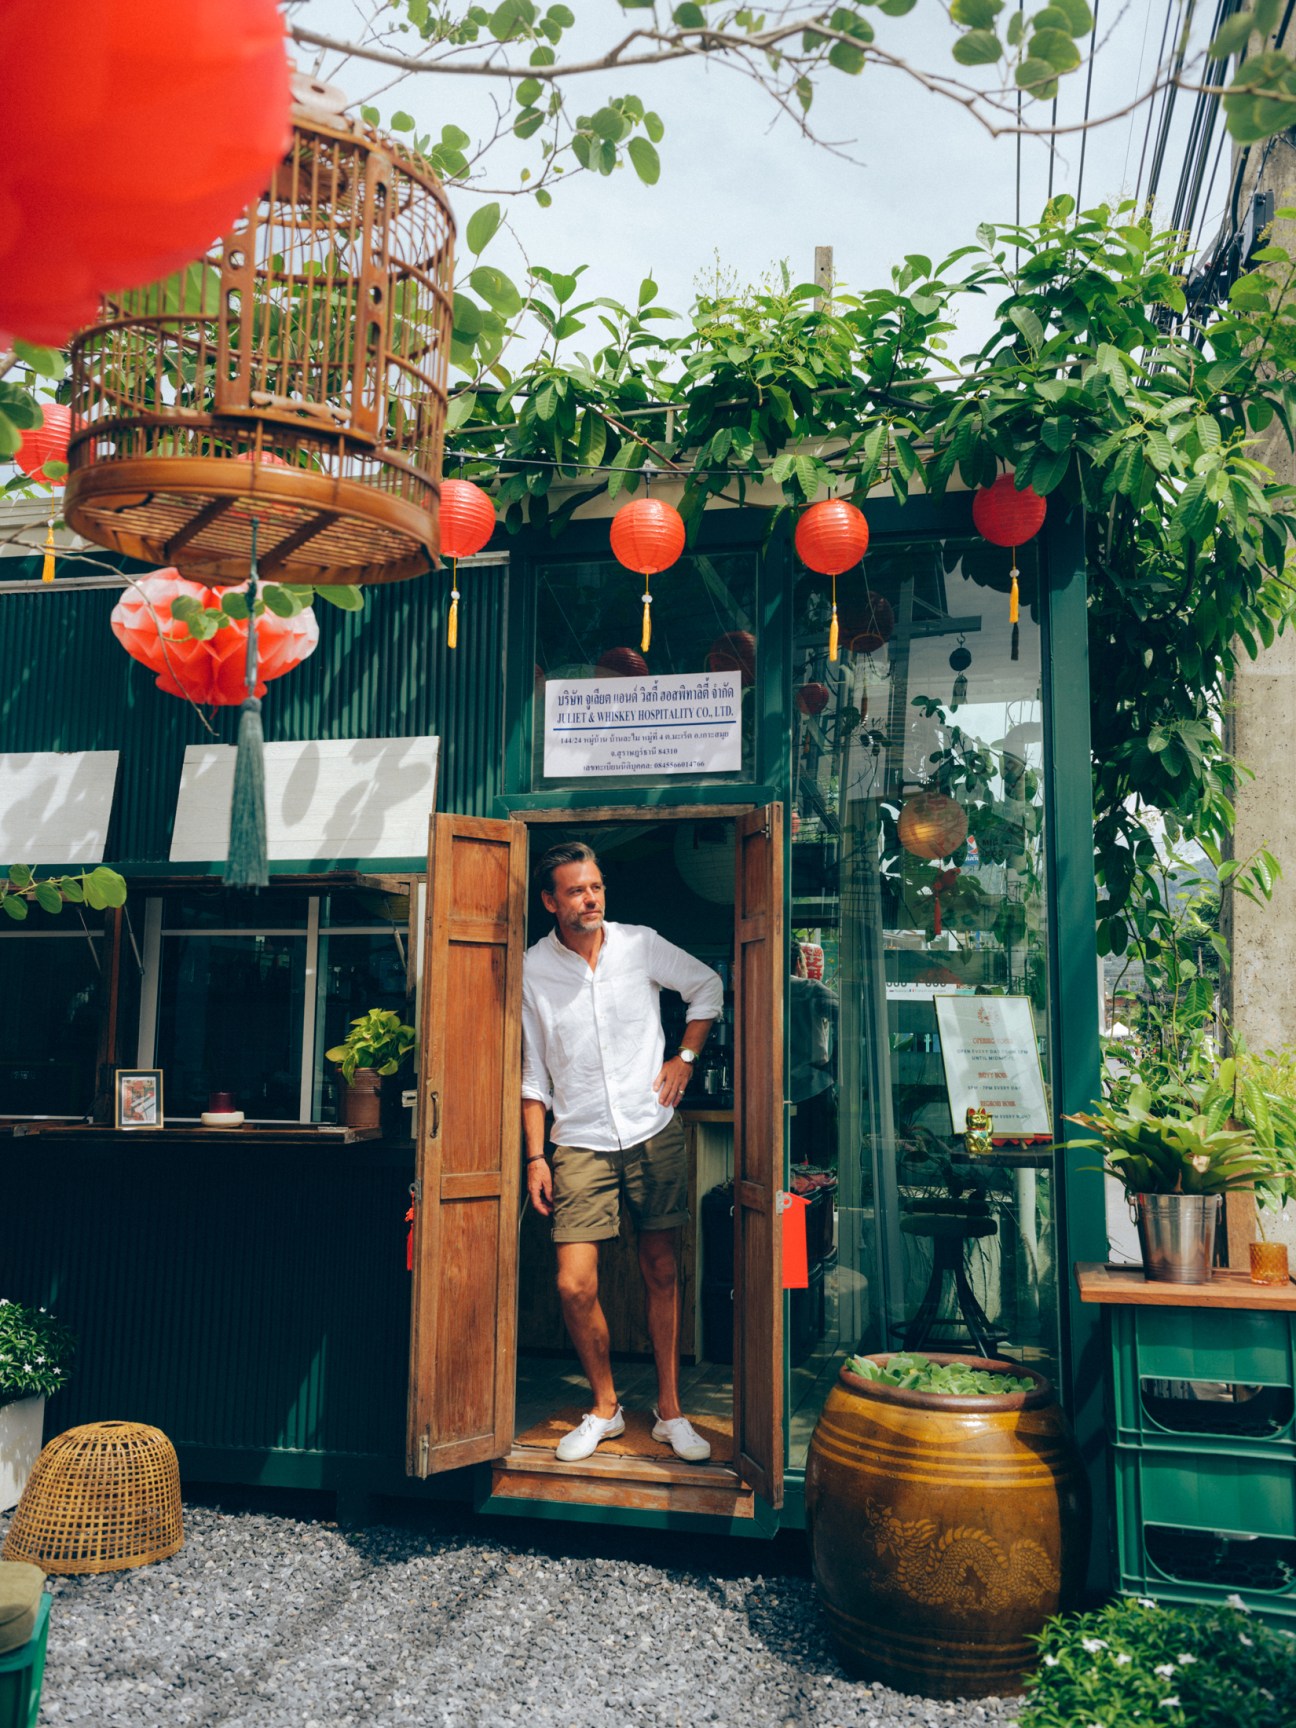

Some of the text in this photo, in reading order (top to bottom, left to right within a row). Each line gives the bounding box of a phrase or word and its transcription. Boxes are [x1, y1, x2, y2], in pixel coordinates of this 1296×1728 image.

[558, 689, 583, 706] บริษัท
[613, 684, 638, 704] แอนด์
[712, 682, 734, 699] จำกัด
[557, 712, 586, 723] JULIET
[588, 712, 595, 723] &
[597, 711, 636, 722] WHISKEY
[638, 708, 694, 720] HOSPITALITY
[714, 705, 733, 717] LTD.
